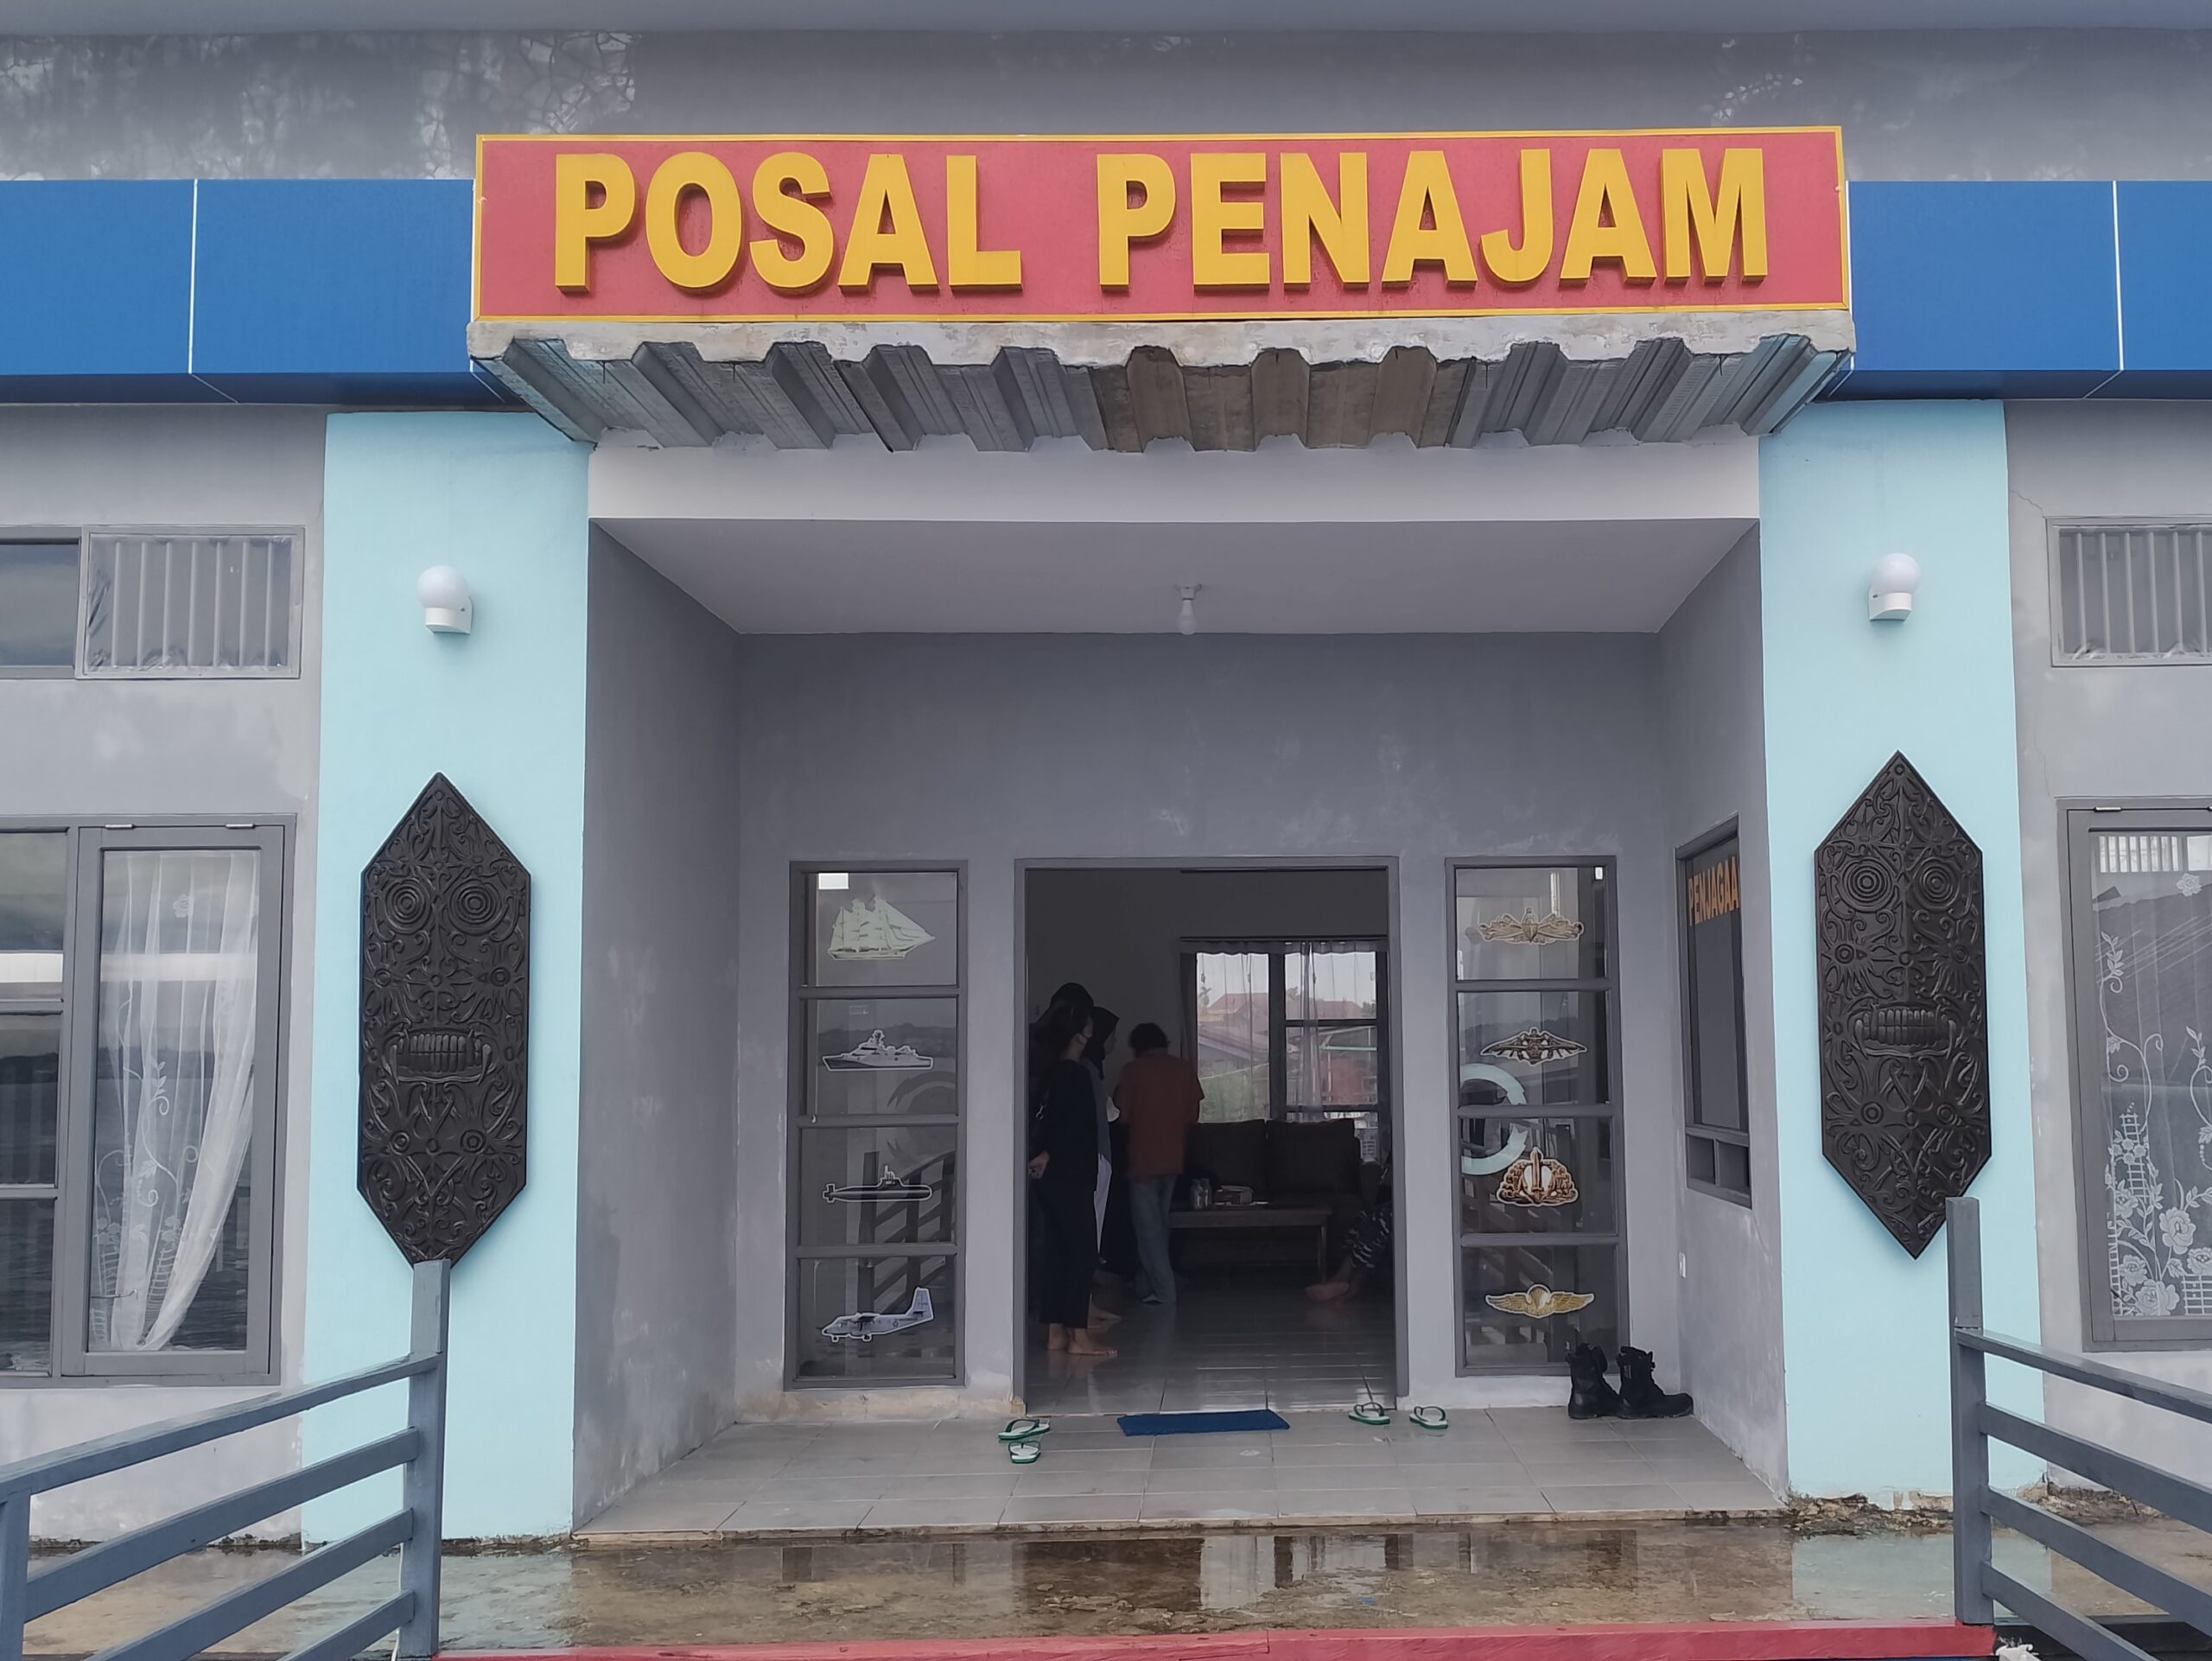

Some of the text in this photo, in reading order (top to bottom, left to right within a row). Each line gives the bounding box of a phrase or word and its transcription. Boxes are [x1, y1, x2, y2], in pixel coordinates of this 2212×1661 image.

[555, 148, 1769, 293] POSAL PENAJAM
[1688, 856, 1740, 926] PENJAGAA
